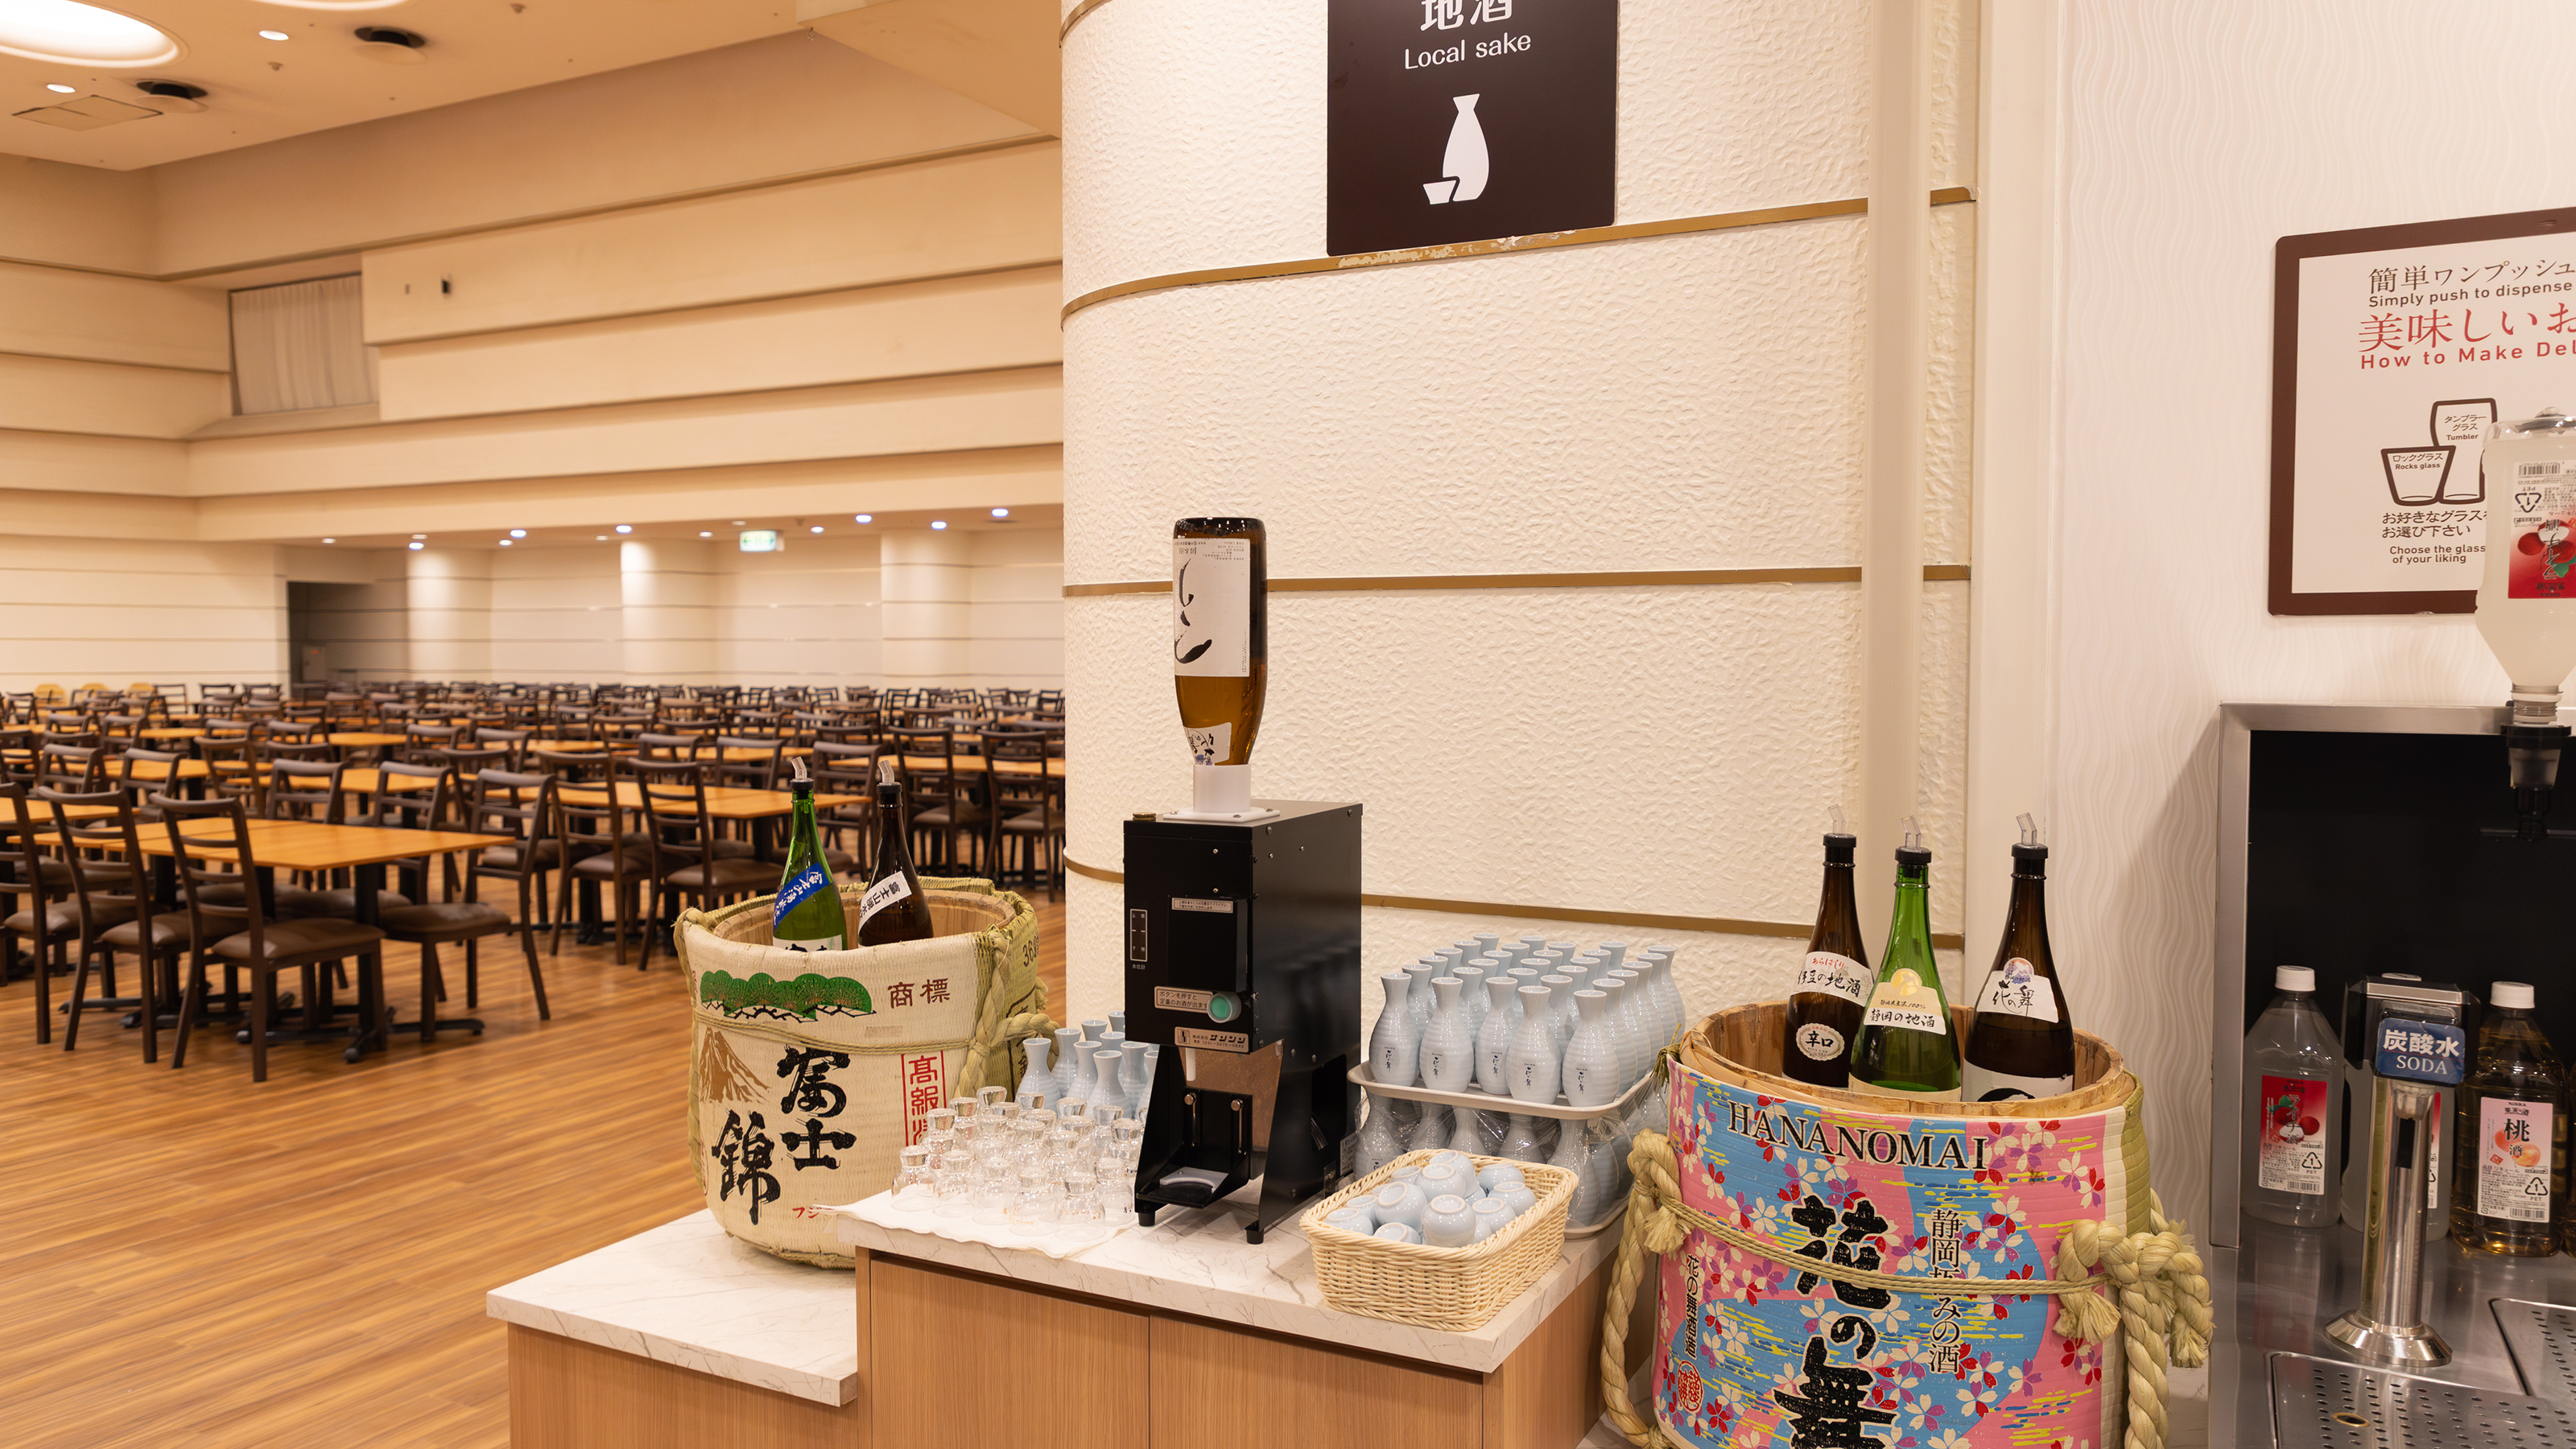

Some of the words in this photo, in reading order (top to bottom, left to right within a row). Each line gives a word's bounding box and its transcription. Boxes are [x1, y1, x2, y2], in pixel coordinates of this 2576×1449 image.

[1420, 0, 1513, 31] 地酒
[1405, 39, 1465, 69] Local
[1476, 32, 1531, 58] sake
[2368, 260, 2575, 294] 簡単ワンプッシュ
[2369, 293, 2424, 308] Simply
[2429, 288, 2468, 304] push
[2475, 287, 2490, 298] to
[2496, 282, 2572, 297] dispense
[2361, 354, 2411, 369] How
[2423, 352, 2446, 365] to
[2458, 345, 2523, 362] Make
[2452, 423, 2478, 431] グラス
[2392, 453, 2443, 462] ロックグラス
[2382, 510, 2487, 524] お好きなグラス
[2382, 525, 2471, 538] お選び下さい
[2390, 546, 2430, 555] Choose
[2434, 545, 2452, 553] the
[2455, 544, 2486, 554] glass
[2392, 555, 2403, 564] of
[2406, 556, 2432, 564] your
[2435, 554, 2467, 564] liking
[887, 977, 951, 1009] 商標
[1798, 969, 1861, 997] 伊豆の地酒
[1159, 991, 1198, 1000] ボタンを押すと
[1870, 1008, 1934, 1028] 静岡の地酒
[1805, 1030, 1834, 1047] 辛口
[2383, 1030, 2459, 1057] 炭酸水
[2396, 1055, 2447, 1075] SODA
[1728, 1100, 1988, 1170] HANANOMAI
